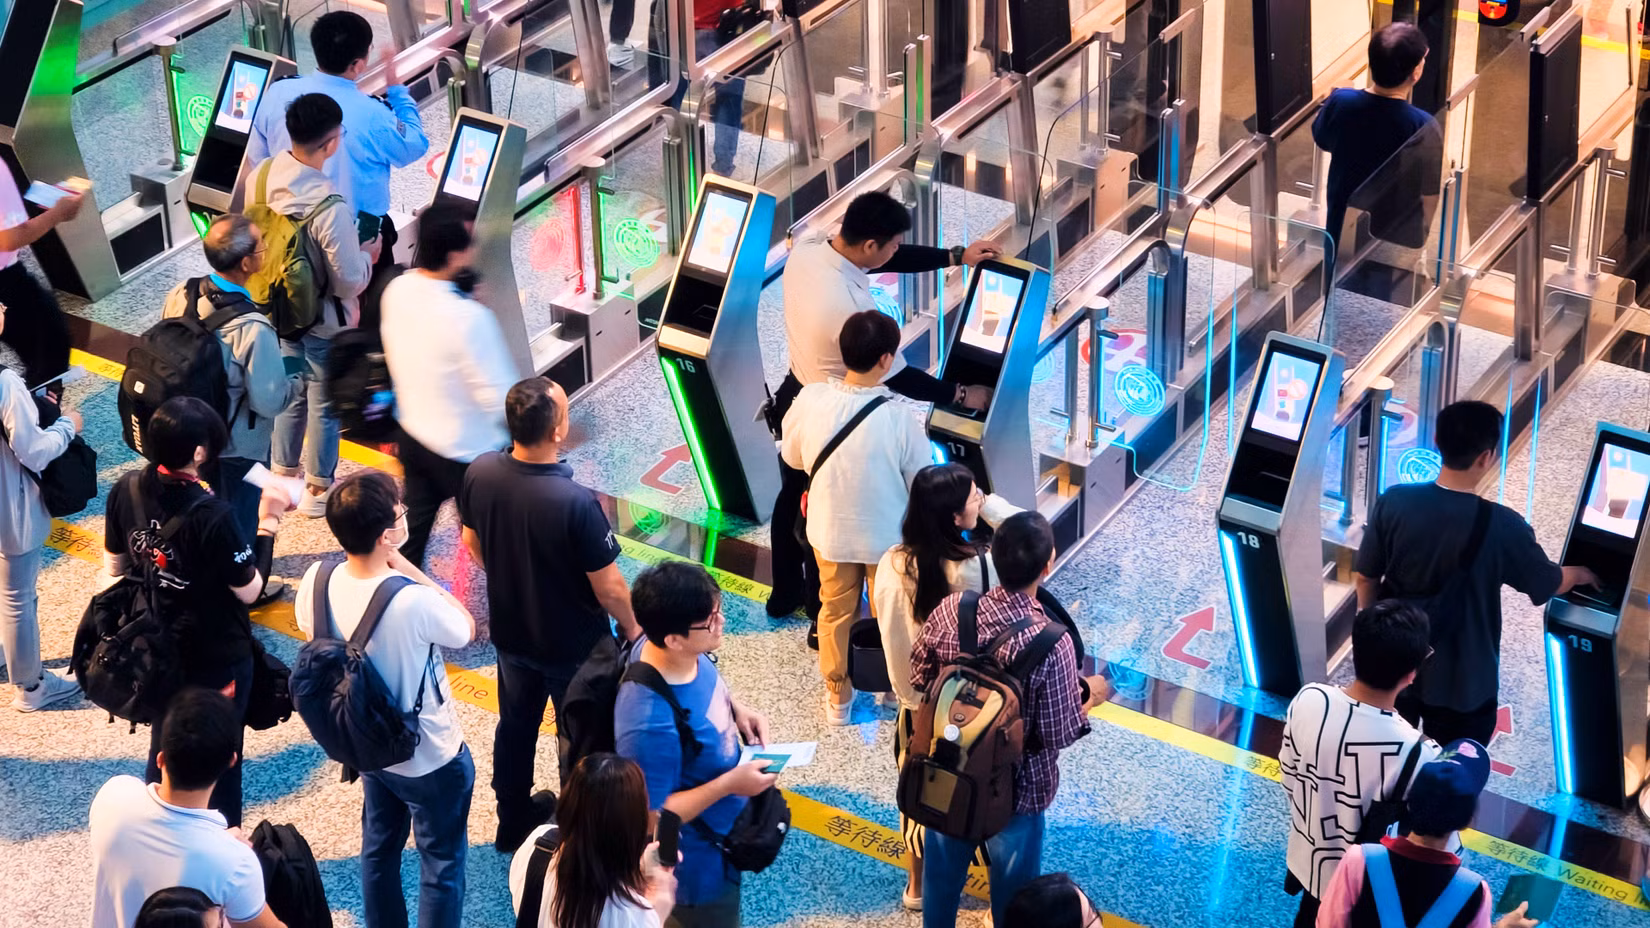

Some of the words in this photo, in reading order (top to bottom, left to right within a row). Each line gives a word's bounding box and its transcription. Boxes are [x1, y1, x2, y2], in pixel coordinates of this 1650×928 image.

[676, 357, 696, 373] 16
[947, 442, 965, 457] 17
[1237, 531, 1260, 549] 18
[1567, 634, 1592, 653] 19
[449, 676, 488, 699] line
[825, 815, 907, 859] 等待線
[1487, 841, 1549, 872] 等待線
[1557, 865, 1628, 901] Waiting
